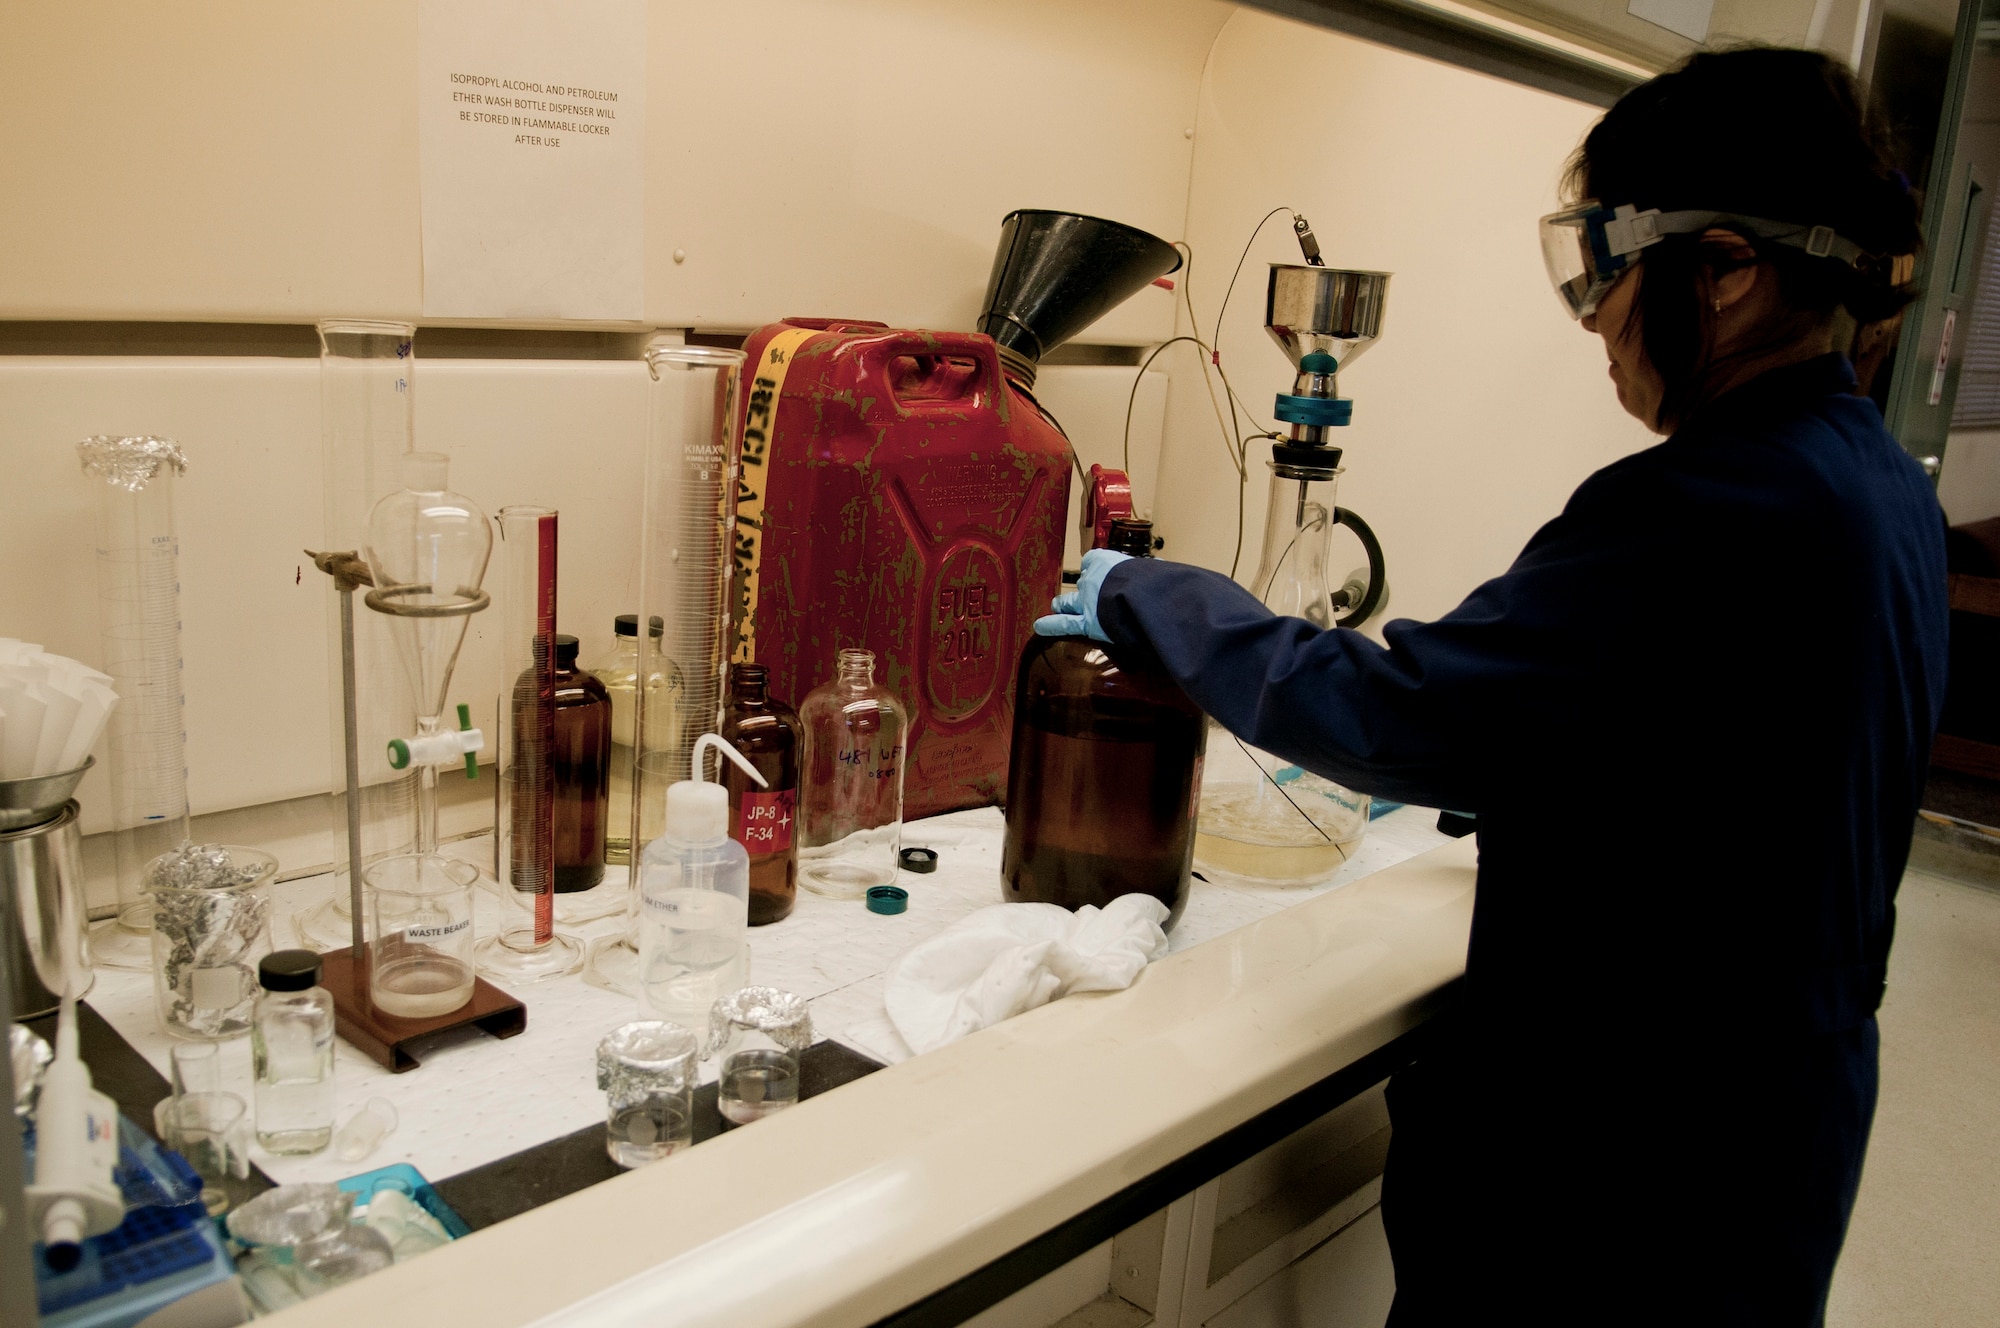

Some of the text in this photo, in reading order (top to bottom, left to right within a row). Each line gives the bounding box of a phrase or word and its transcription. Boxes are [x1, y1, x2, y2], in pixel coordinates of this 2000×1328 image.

[450, 73, 618, 102] ISOPROPYL ALCOHOL AND PETROLEUM
[453, 92, 616, 119] ETHER WASH BOTTLE DISPENSER WILL
[460, 111, 610, 135] BE STORED IN FLAMMABLE LOCKER
[515, 134, 560, 148] AFTER USE
[938, 584, 993, 625] FUEL
[943, 627, 984, 665] 20L
[747, 806, 776, 820] JP-8
[745, 826, 773, 841] F-34
[654, 900, 678, 912] ETHER
[408, 928, 442, 937] WASTE
